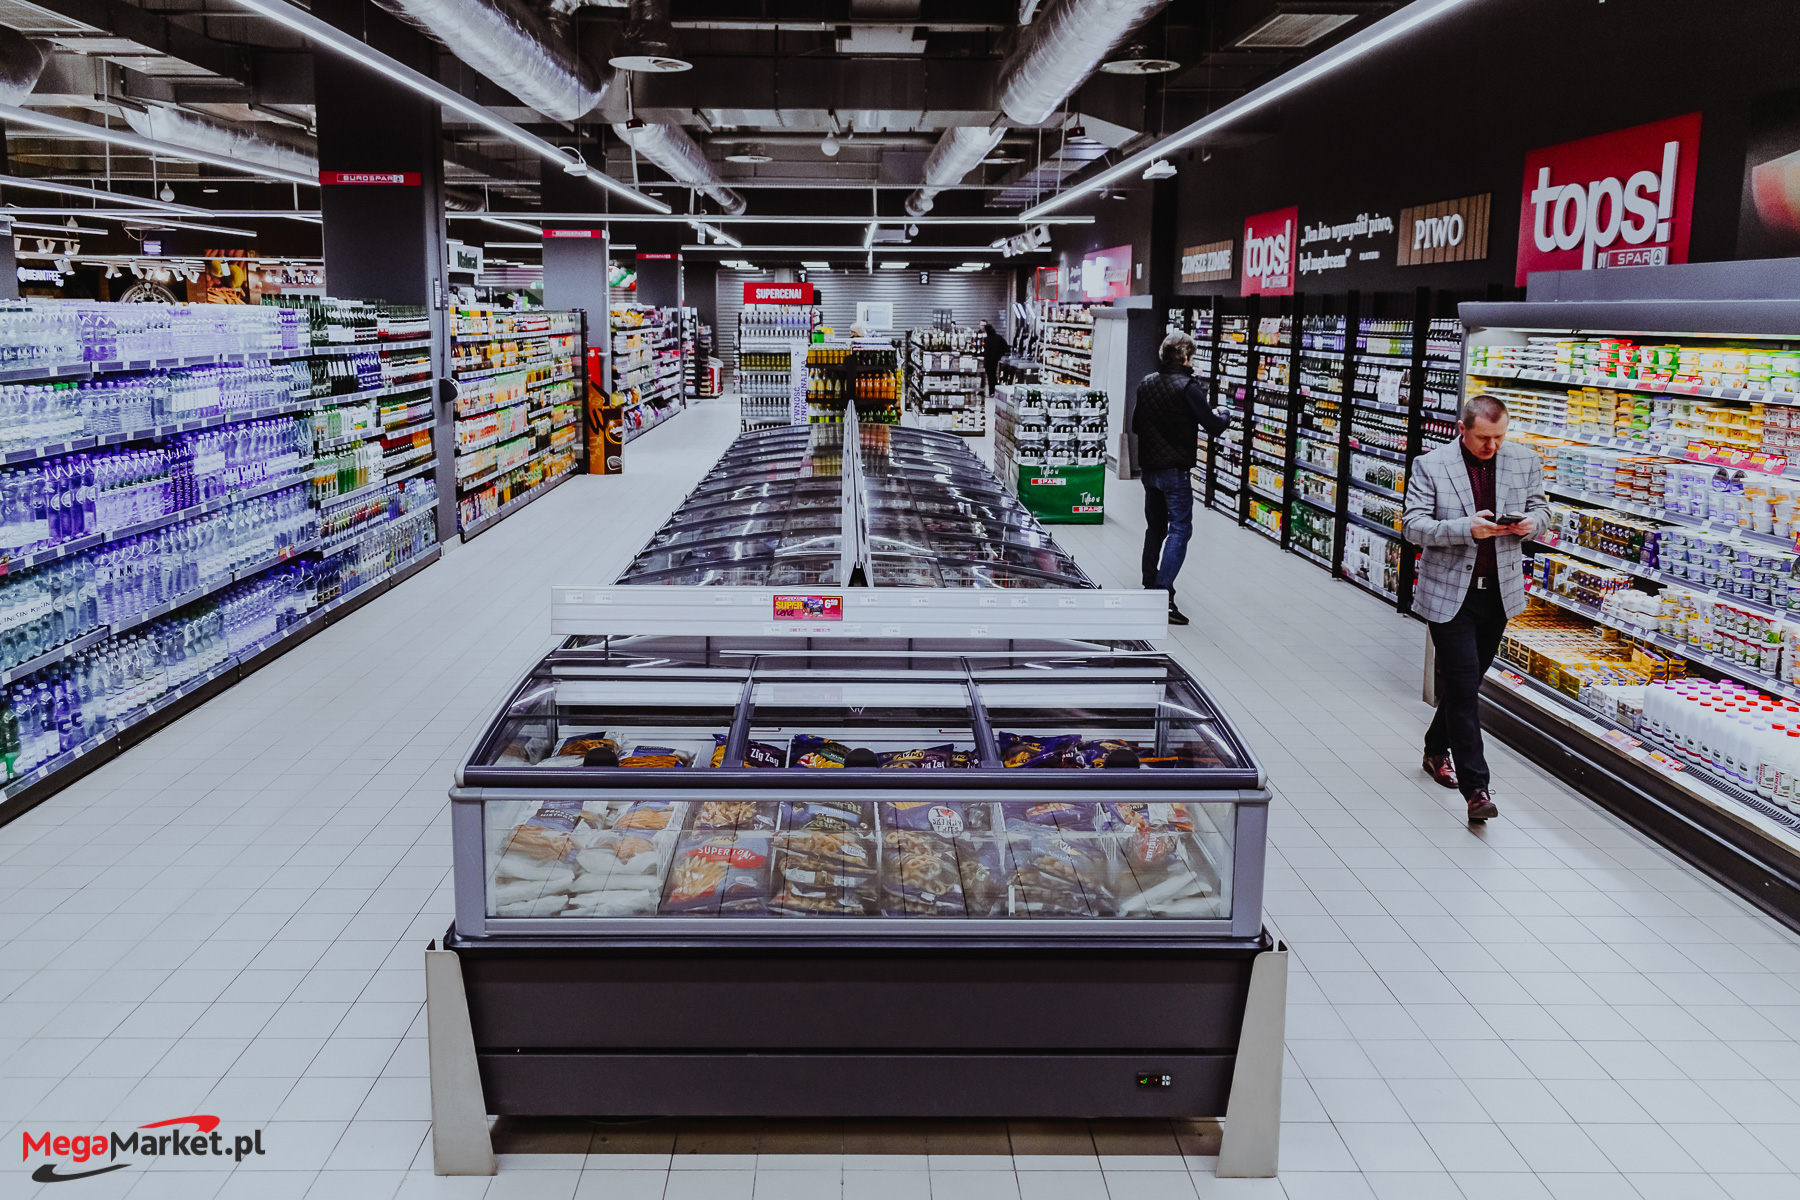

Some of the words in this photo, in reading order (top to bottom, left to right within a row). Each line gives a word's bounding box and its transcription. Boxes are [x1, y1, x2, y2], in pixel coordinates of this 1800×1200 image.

[1531, 141, 1680, 270] tops!
[1414, 213, 1463, 250] PIWO
[1246, 219, 1291, 288] tops!
[1597, 252, 1607, 269] BY
[1617, 252, 1651, 265] SPAR
[801, 273, 806, 283] 1
[921, 274, 928, 284] 2
[1039, 464, 1054, 478] Tylko
[1080, 491, 1096, 506] Tylko
[775, 601, 804, 610] SUPER
[750, 748, 764, 762] Zig
[765, 752, 780, 767] Zag
[698, 846, 731, 856] SUPER
